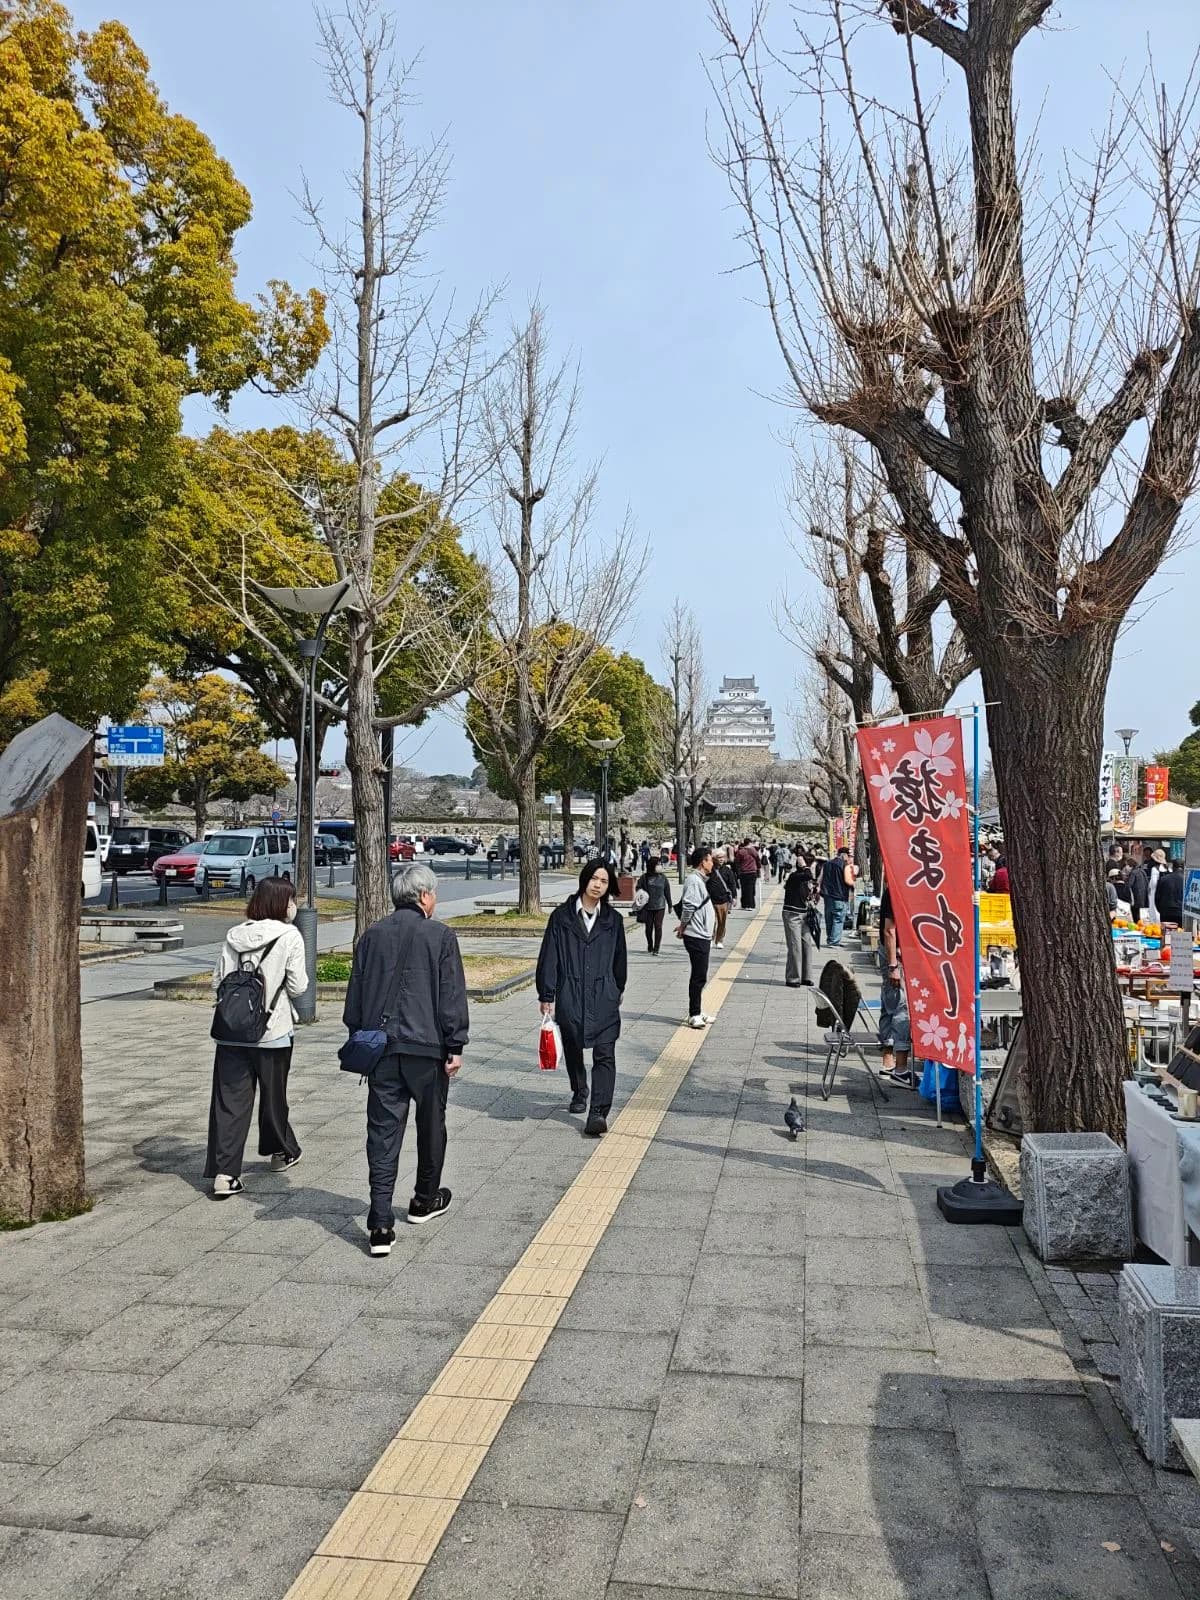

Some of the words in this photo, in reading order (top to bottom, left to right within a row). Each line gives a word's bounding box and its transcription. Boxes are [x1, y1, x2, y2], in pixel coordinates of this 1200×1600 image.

[1119, 761, 1132, 824] みたらし団子
